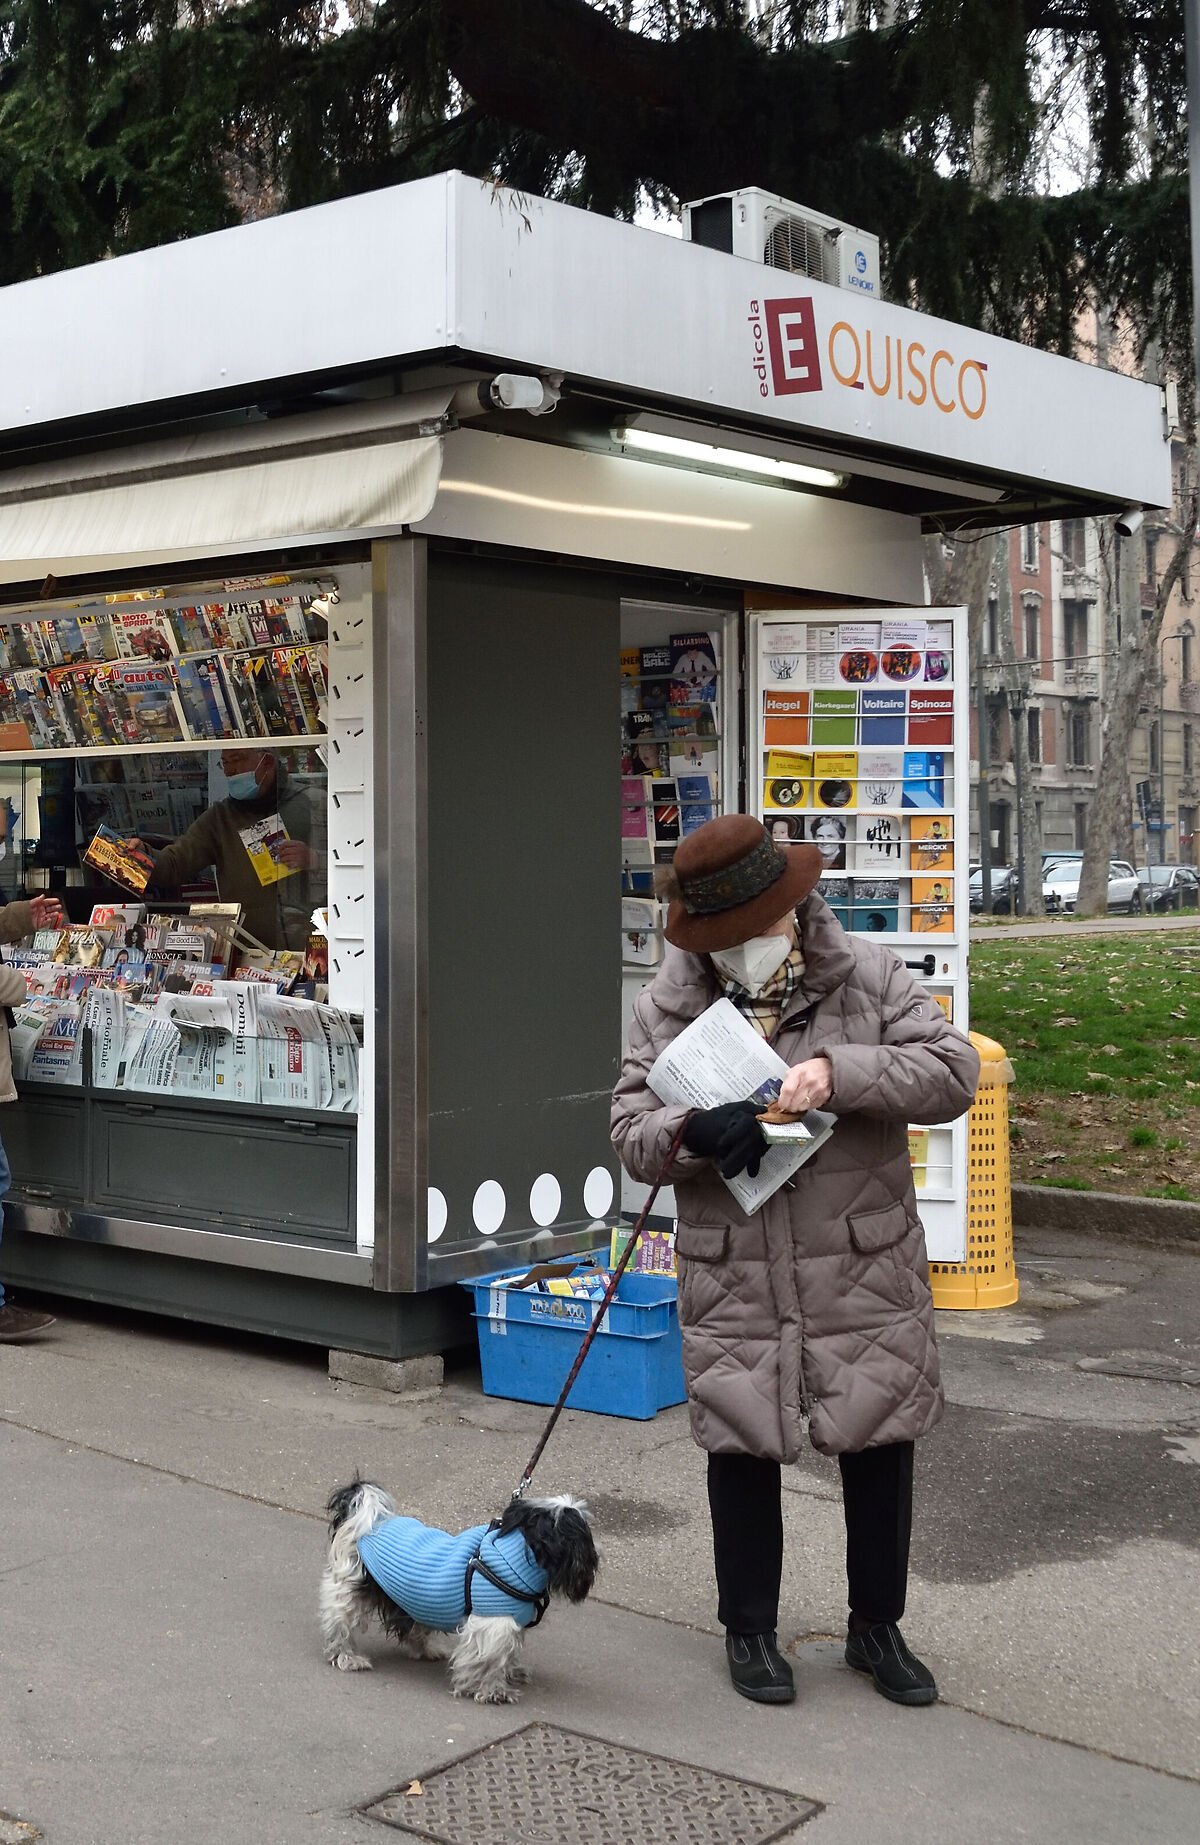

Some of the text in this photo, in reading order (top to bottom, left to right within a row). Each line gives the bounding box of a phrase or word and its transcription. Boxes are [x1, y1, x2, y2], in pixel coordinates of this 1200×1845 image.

[848, 275, 874, 291] LENOIR
[748, 299, 769, 398] edicola
[122, 613, 148, 622] MOTO
[123, 619, 154, 628] SPRINT
[124, 671, 165, 684] auto
[767, 700, 800, 711] Hegel
[814, 702, 856, 710] Kierkegaard
[864, 700, 904, 709] Voltaire
[910, 700, 952, 710] Spinoza
[184, 963, 212, 975] prima
[236, 993, 247, 1056] Domani
[101, 1017, 113, 1068] Giornale
